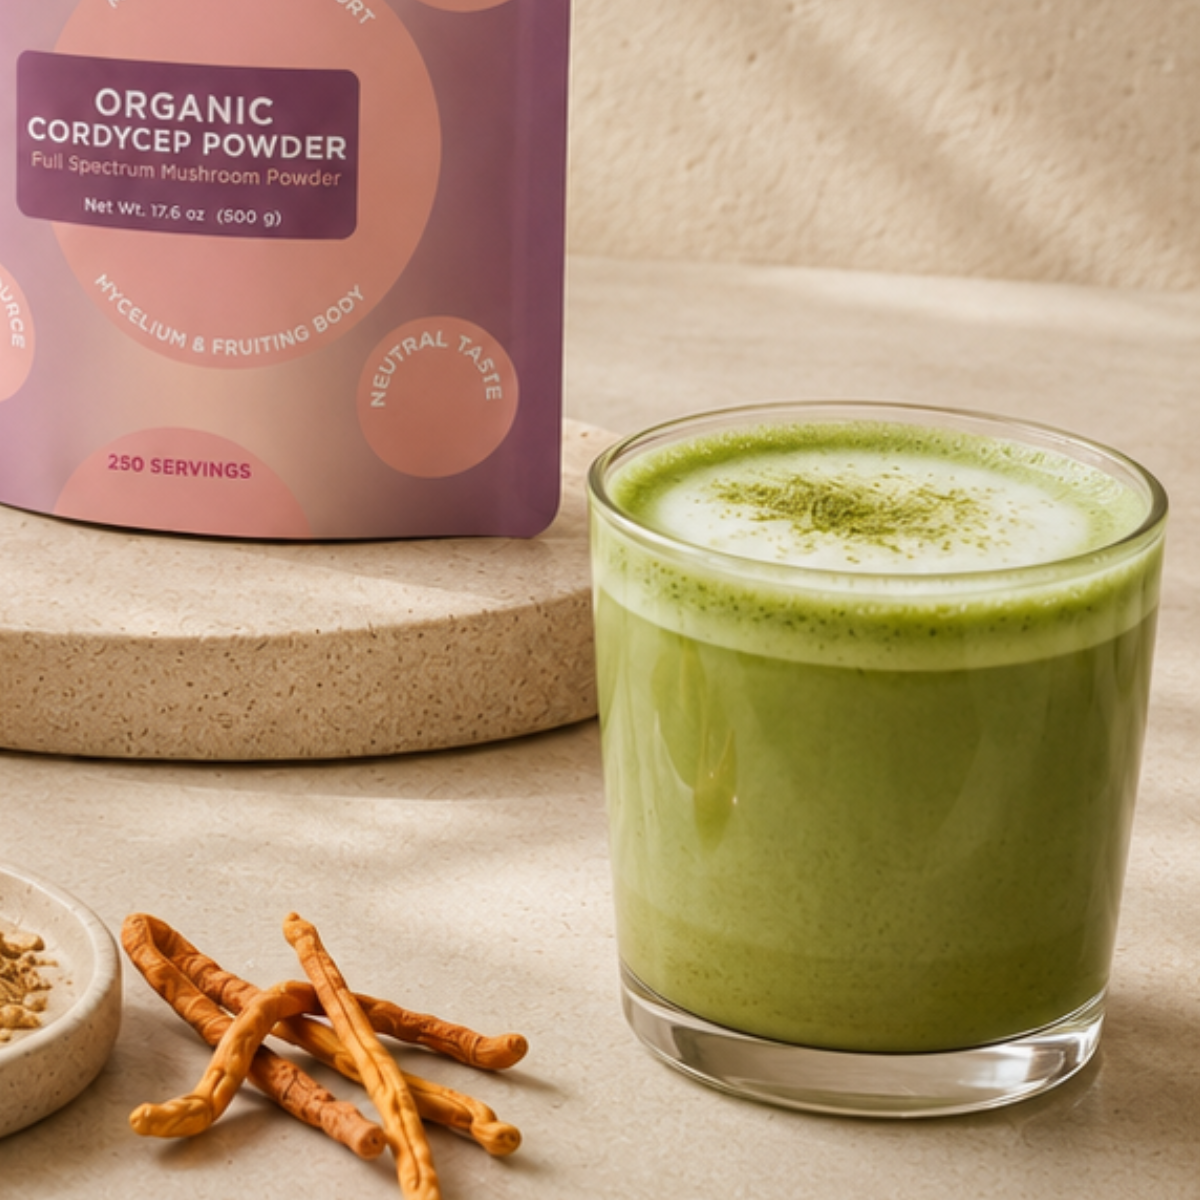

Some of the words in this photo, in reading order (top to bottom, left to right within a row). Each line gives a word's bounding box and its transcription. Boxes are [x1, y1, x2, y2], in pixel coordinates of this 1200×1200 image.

[95, 87, 274, 126] ORGANIC
[27, 116, 192, 154] CORDYCEP
[203, 131, 347, 161] POWDER
[31, 150, 64, 170] Full
[68, 154, 155, 177] Spectrum
[161, 163, 261, 186] Mushroom
[267, 168, 342, 187] Powder
[84, 197, 113, 215] Net
[117, 201, 146, 217] Wt.
[151, 204, 181, 220] 17.6
[186, 208, 205, 222] oz
[216, 208, 258, 226] (500
[263, 210, 282, 228] g)
[191, 337, 205, 352] &
[212, 324, 309, 356] FRUITING
[312, 284, 365, 333] BODY
[370, 330, 449, 408] NEUTRAL
[457, 334, 503, 400] TASTE
[108, 453, 145, 473] 250
[150, 457, 252, 480] SERVINGS
